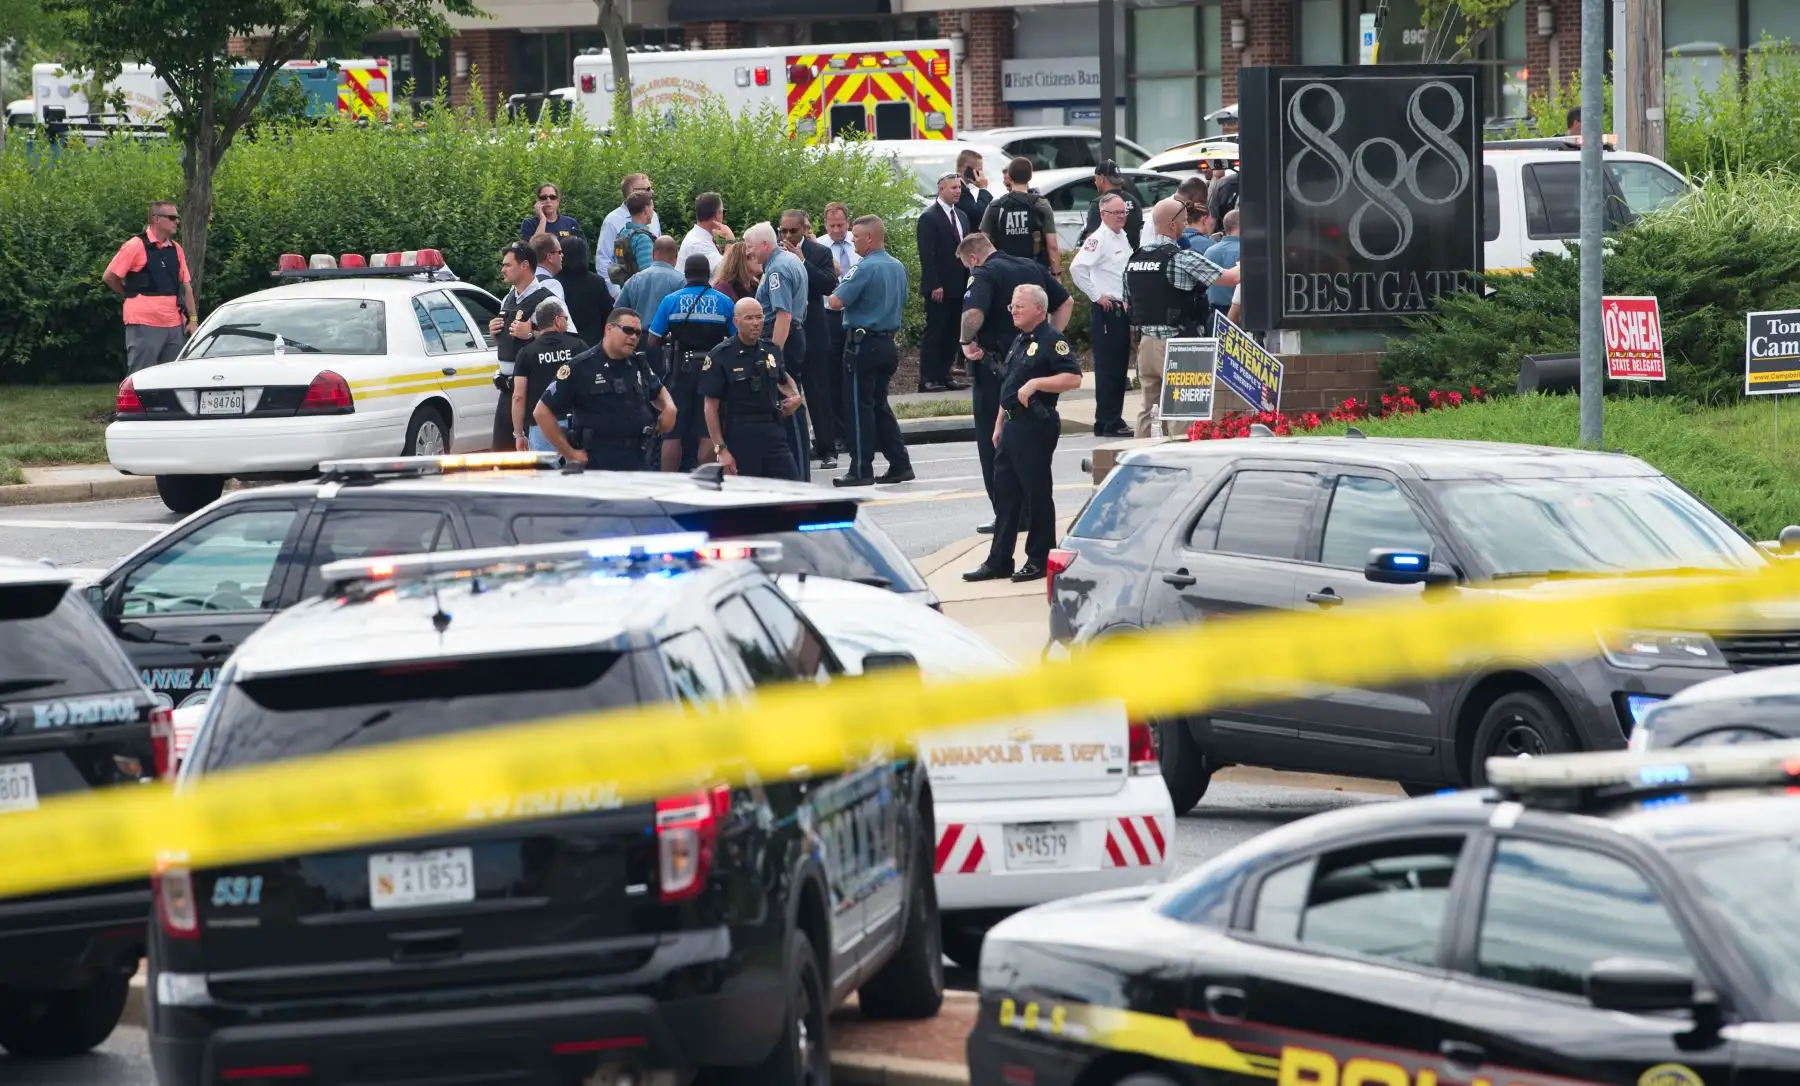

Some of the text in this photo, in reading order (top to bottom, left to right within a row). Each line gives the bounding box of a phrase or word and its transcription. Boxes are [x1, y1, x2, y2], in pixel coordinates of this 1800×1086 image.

[1013, 69, 1100, 88] First Citizens Ban
[1005, 210, 1029, 228] ATF
[1005, 227, 1029, 236] POLICE
[1127, 261, 1161, 271] POLICE
[680, 305, 718, 314] POLICE
[1766, 319, 1800, 335] Ton
[1228, 325, 1280, 373] SHERIFF
[1751, 336, 1800, 357] Cam
[538, 349, 572, 364] POLICE
[1225, 334, 1278, 393] BATEMAN
[1611, 359, 1662, 372] STATE DELEGATE
[1166, 372, 1212, 386] FREDERICKS
[1753, 371, 1800, 380] www.Campbell
[213, 396, 241, 409] 84760
[1180, 388, 1212, 402] SHERIFF
[929, 746, 1023, 768] ANNAPOLIS
[1030, 744, 1064, 764] FIRE
[418, 862, 468, 892] 1853
